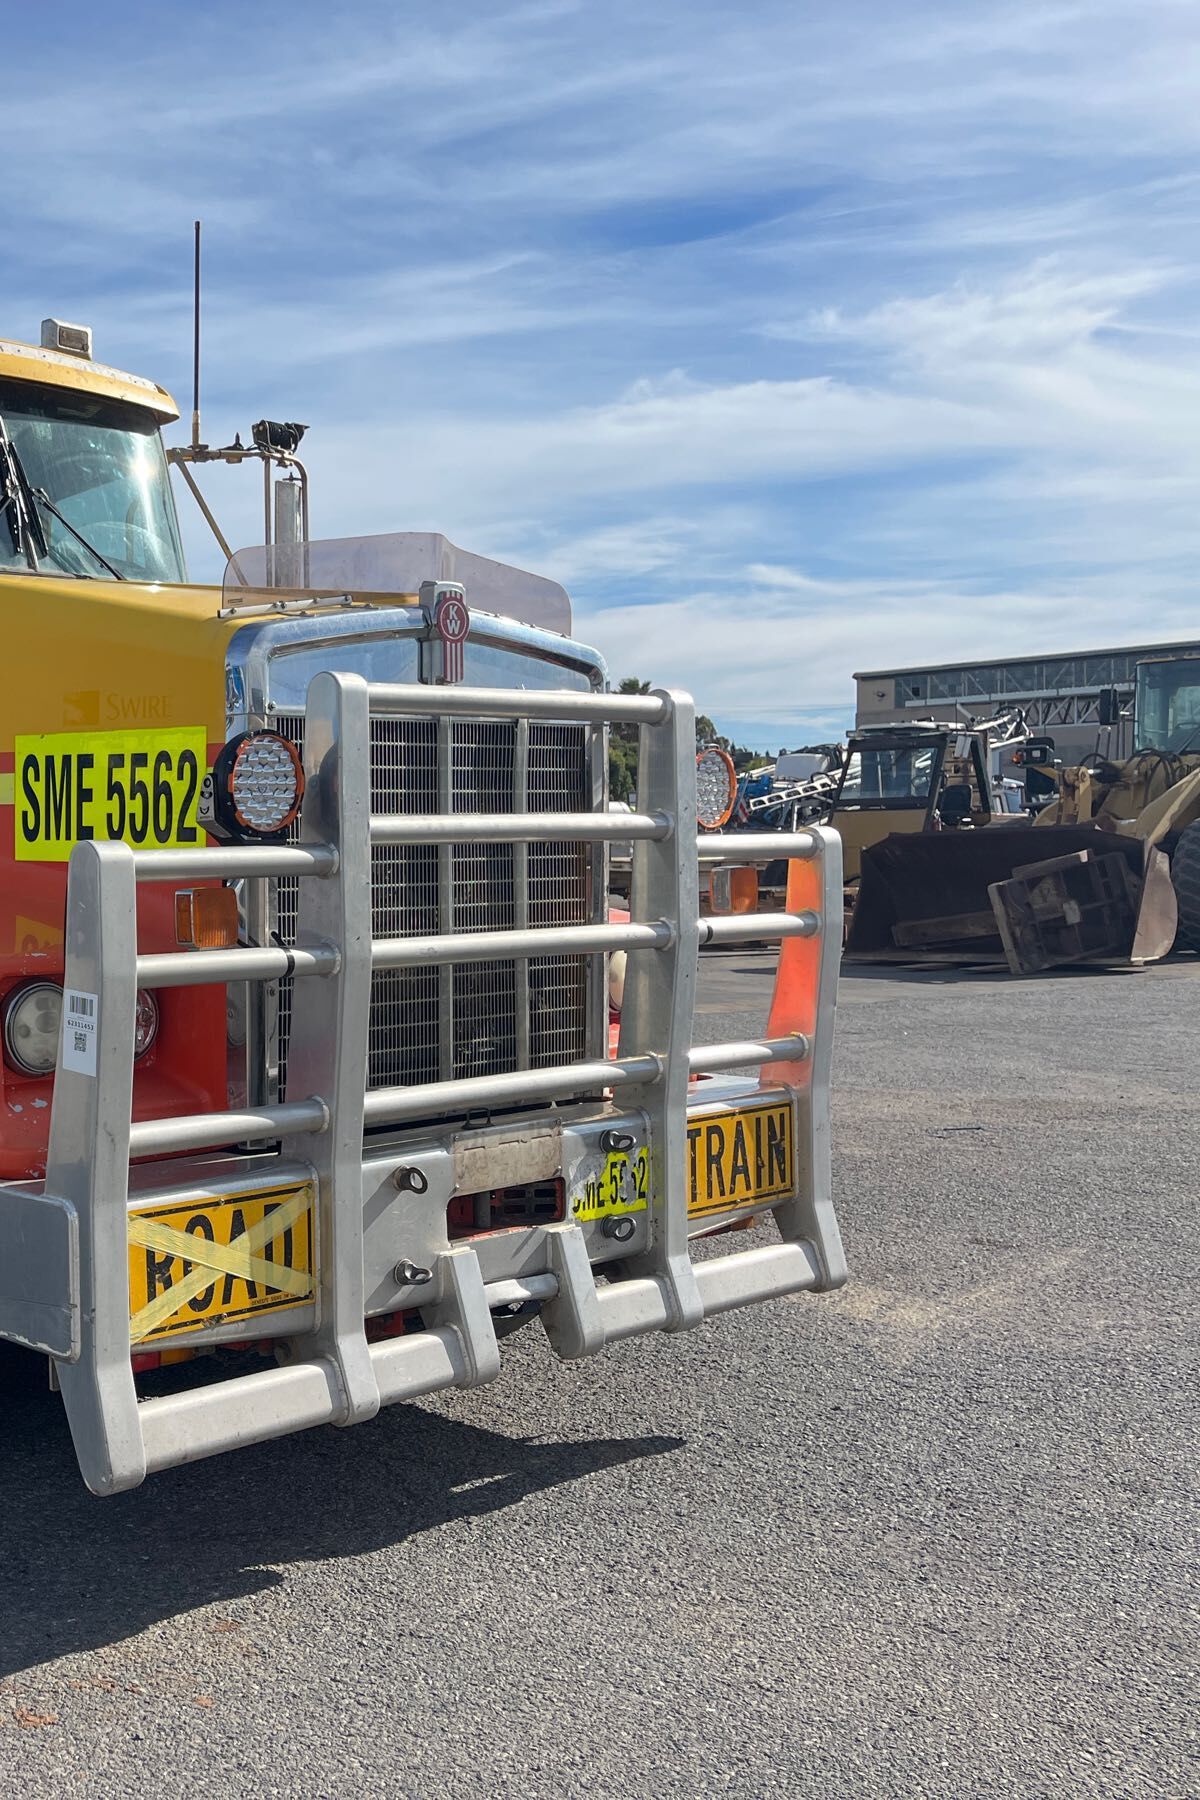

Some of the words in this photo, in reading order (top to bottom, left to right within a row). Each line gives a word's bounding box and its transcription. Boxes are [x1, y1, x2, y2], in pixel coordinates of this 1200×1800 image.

[105, 691, 171, 720] SWIRE
[22, 754, 94, 842] SME
[106, 749, 198, 844] 5562
[686, 1112, 787, 1203] TRAIN
